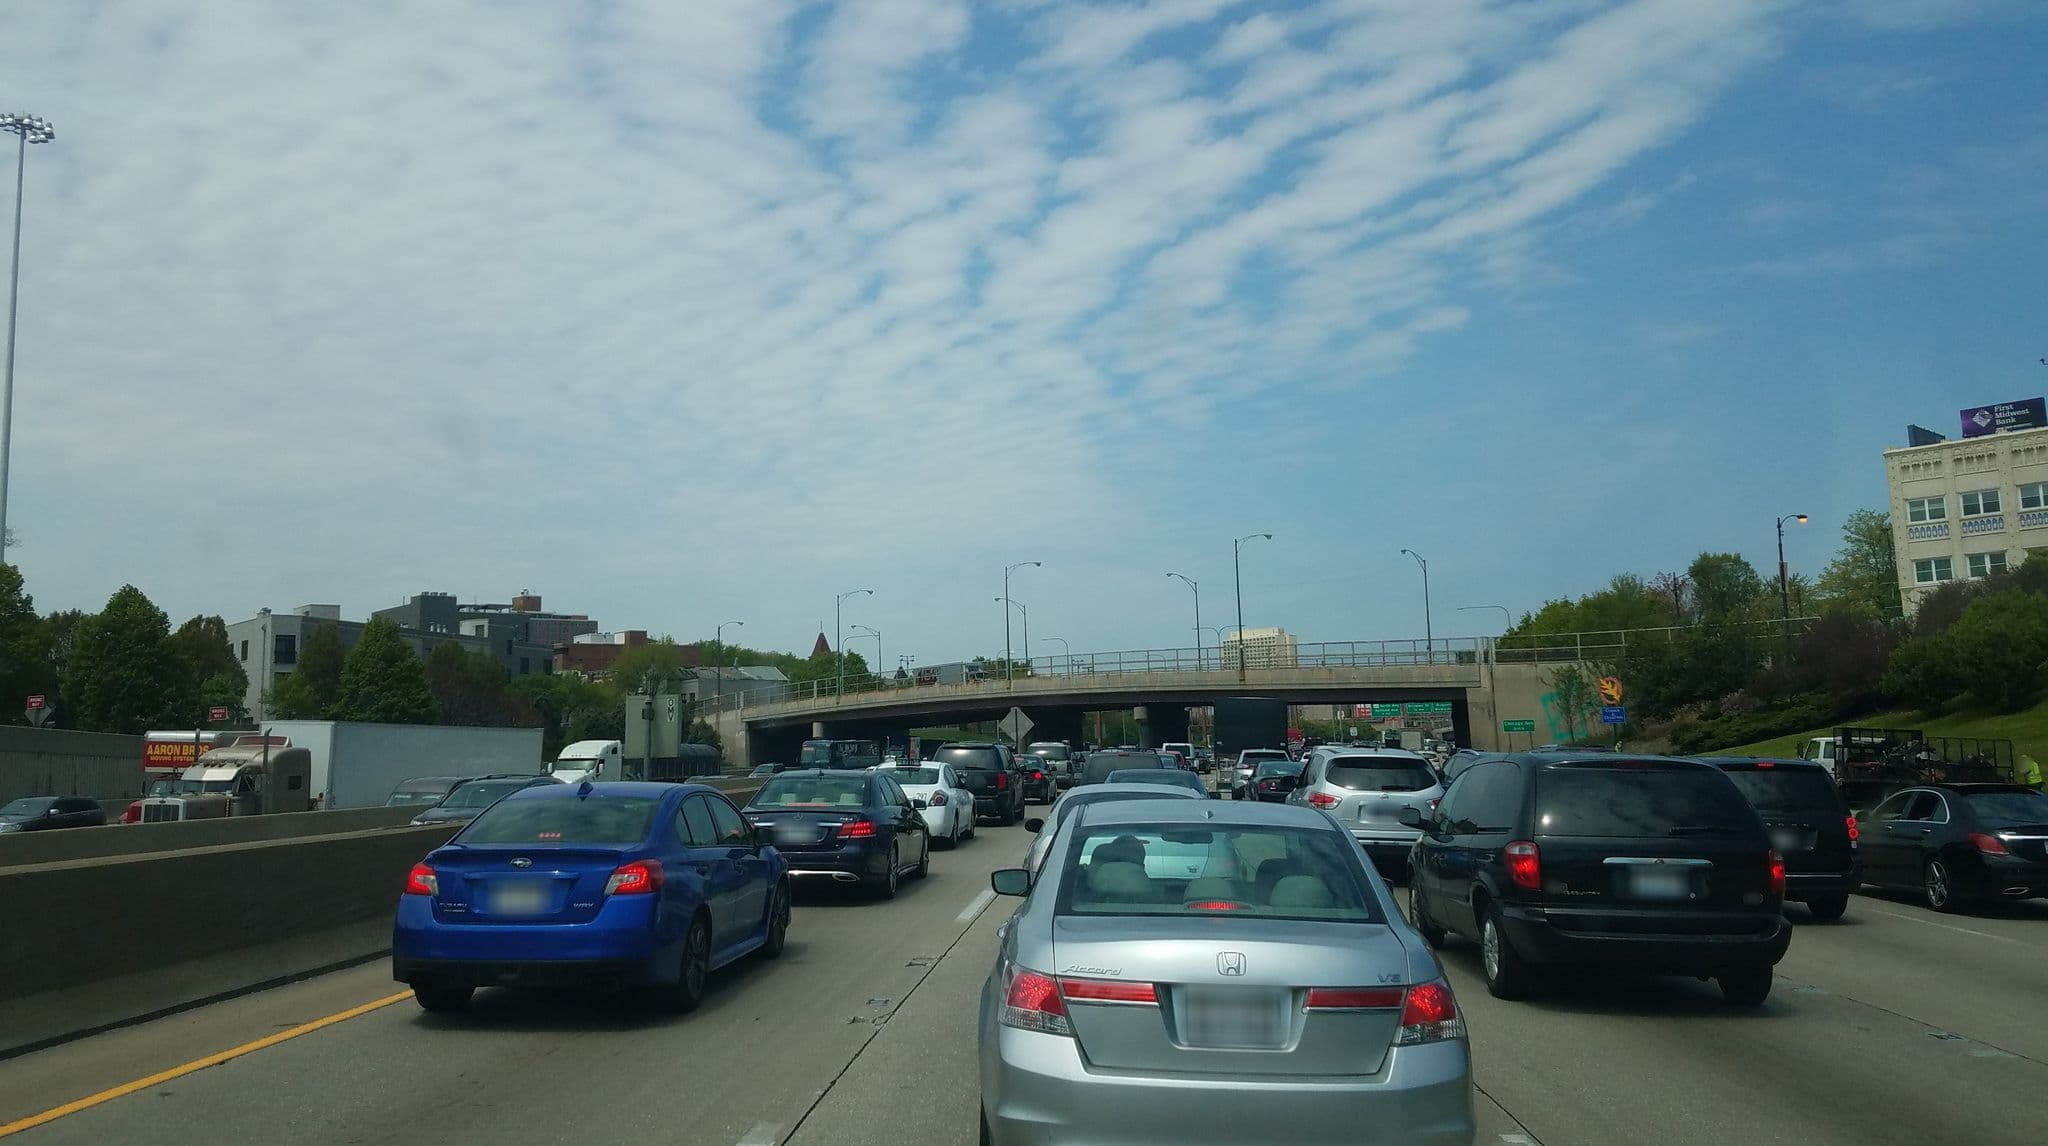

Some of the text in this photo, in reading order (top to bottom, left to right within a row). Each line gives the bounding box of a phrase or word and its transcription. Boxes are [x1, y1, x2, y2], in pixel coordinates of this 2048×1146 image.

[1994, 405, 2014, 413] First
[1994, 408, 2030, 419] Midwest
[1995, 417, 2017, 426] Bank
[147, 744, 180, 756] AARON
[1061, 965, 1122, 976] Accord
